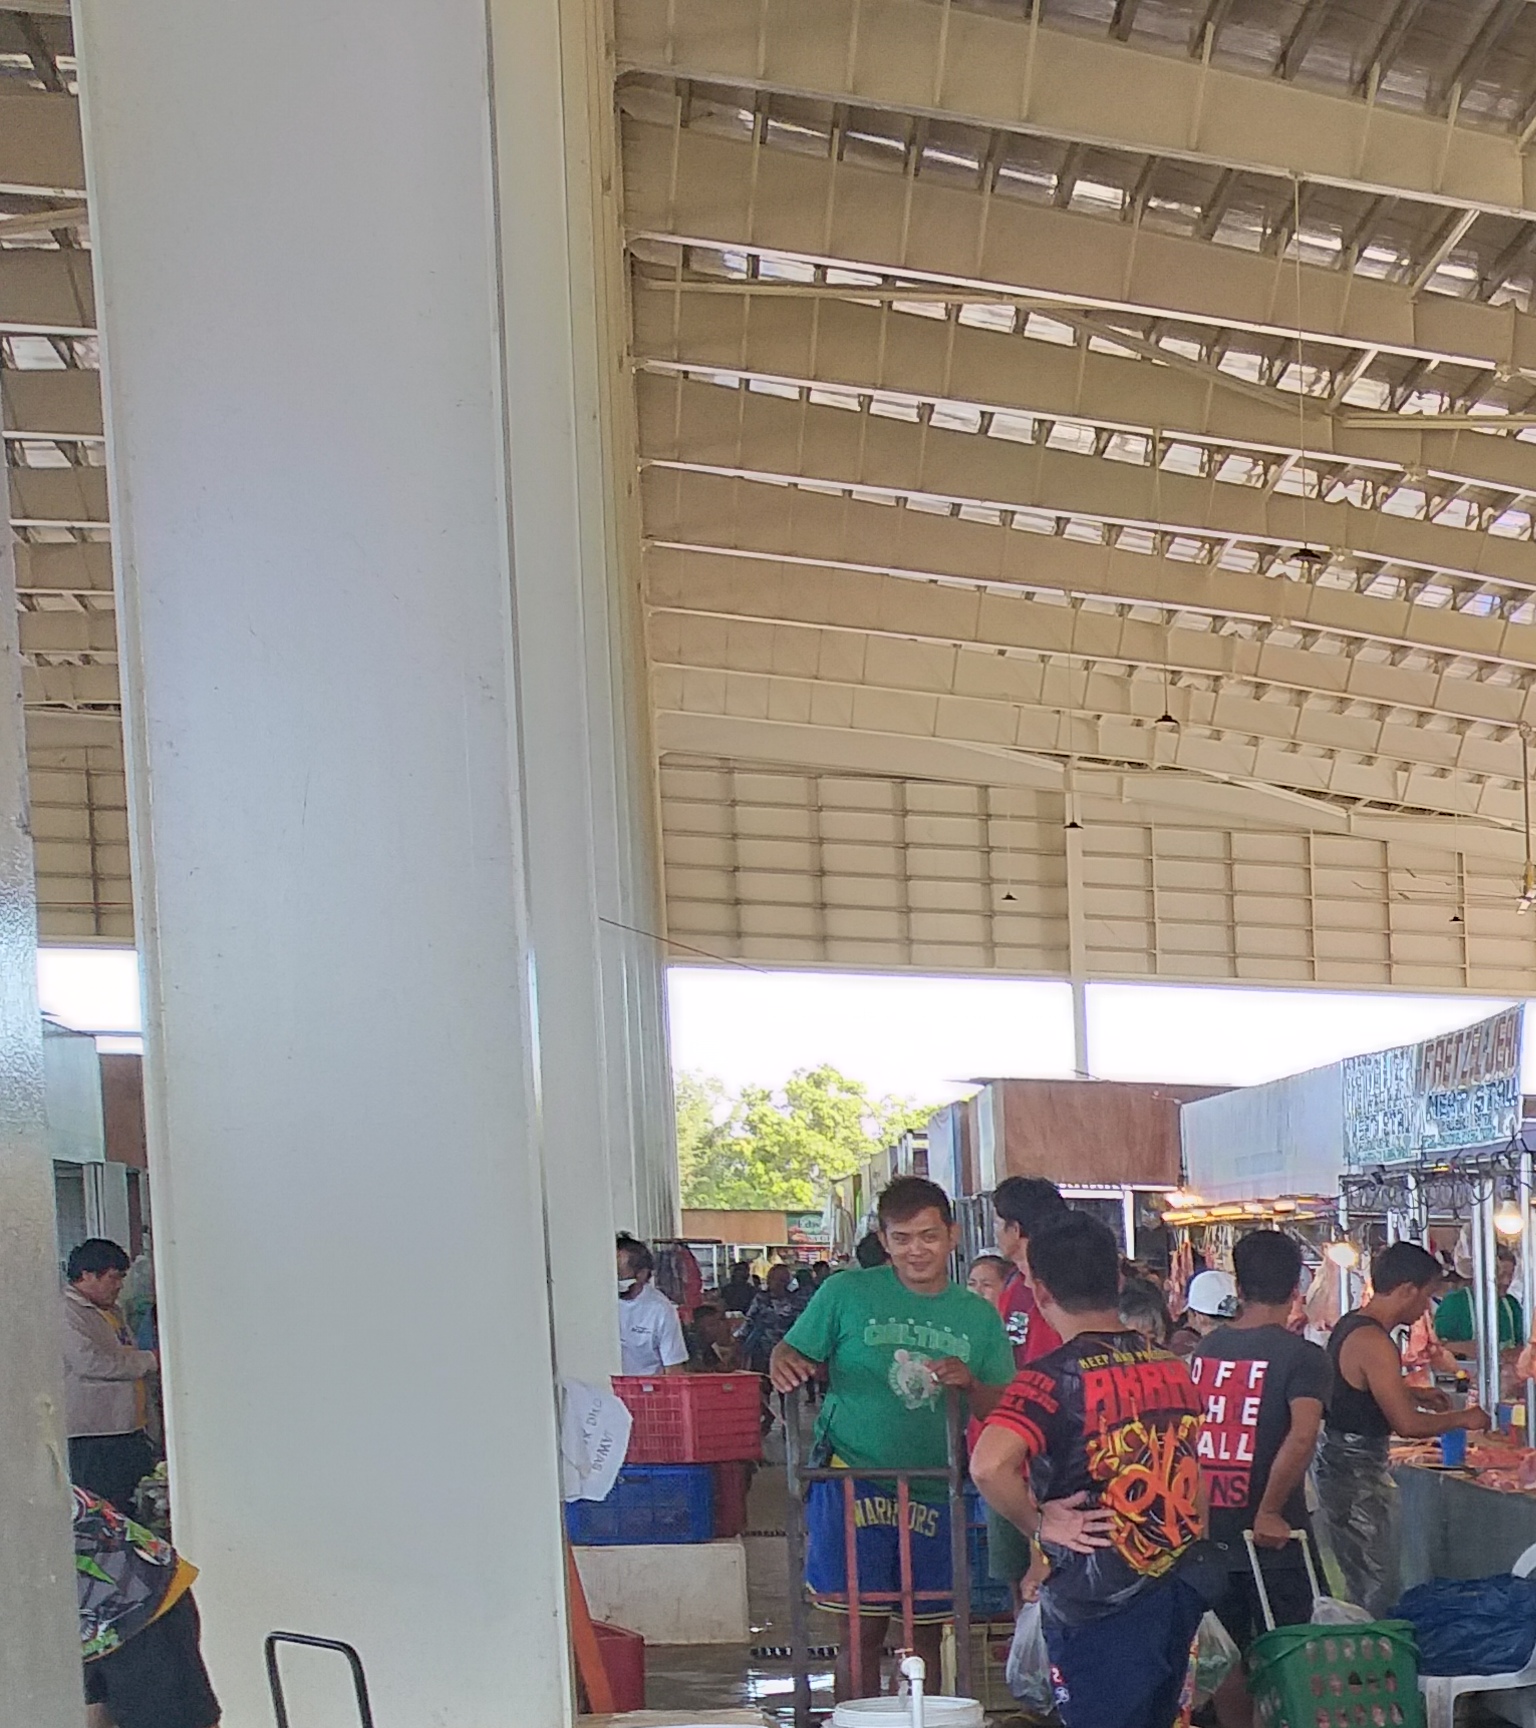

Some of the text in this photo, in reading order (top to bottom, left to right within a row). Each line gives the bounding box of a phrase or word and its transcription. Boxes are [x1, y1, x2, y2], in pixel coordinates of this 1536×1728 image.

[1191, 1356, 1270, 1390] OFF
[1206, 1394, 1262, 1427] HE
[1197, 1430, 1254, 1463] ALL
[1210, 1474, 1248, 1506] NS
[854, 1496, 940, 1538] WARORS
